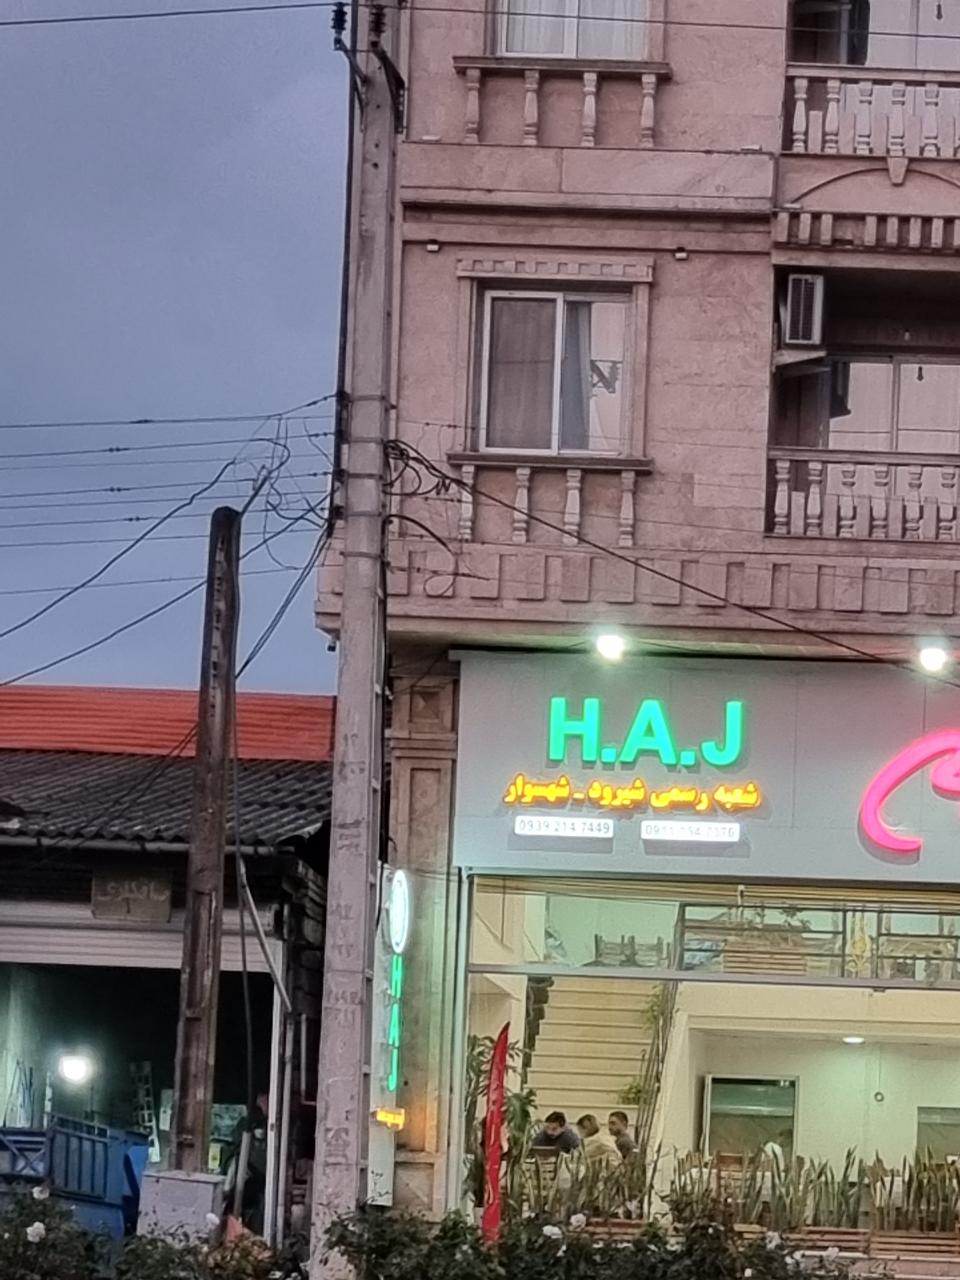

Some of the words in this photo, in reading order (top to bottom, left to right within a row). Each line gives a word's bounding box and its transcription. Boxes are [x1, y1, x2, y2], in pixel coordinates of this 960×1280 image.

[548, 696, 743, 767] H.A.J
[503, 772, 571, 803] شهسوار
[587, 778, 646, 807] شیرود
[649, 787, 709, 811] رسمی
[712, 782, 759, 810] شعبه
